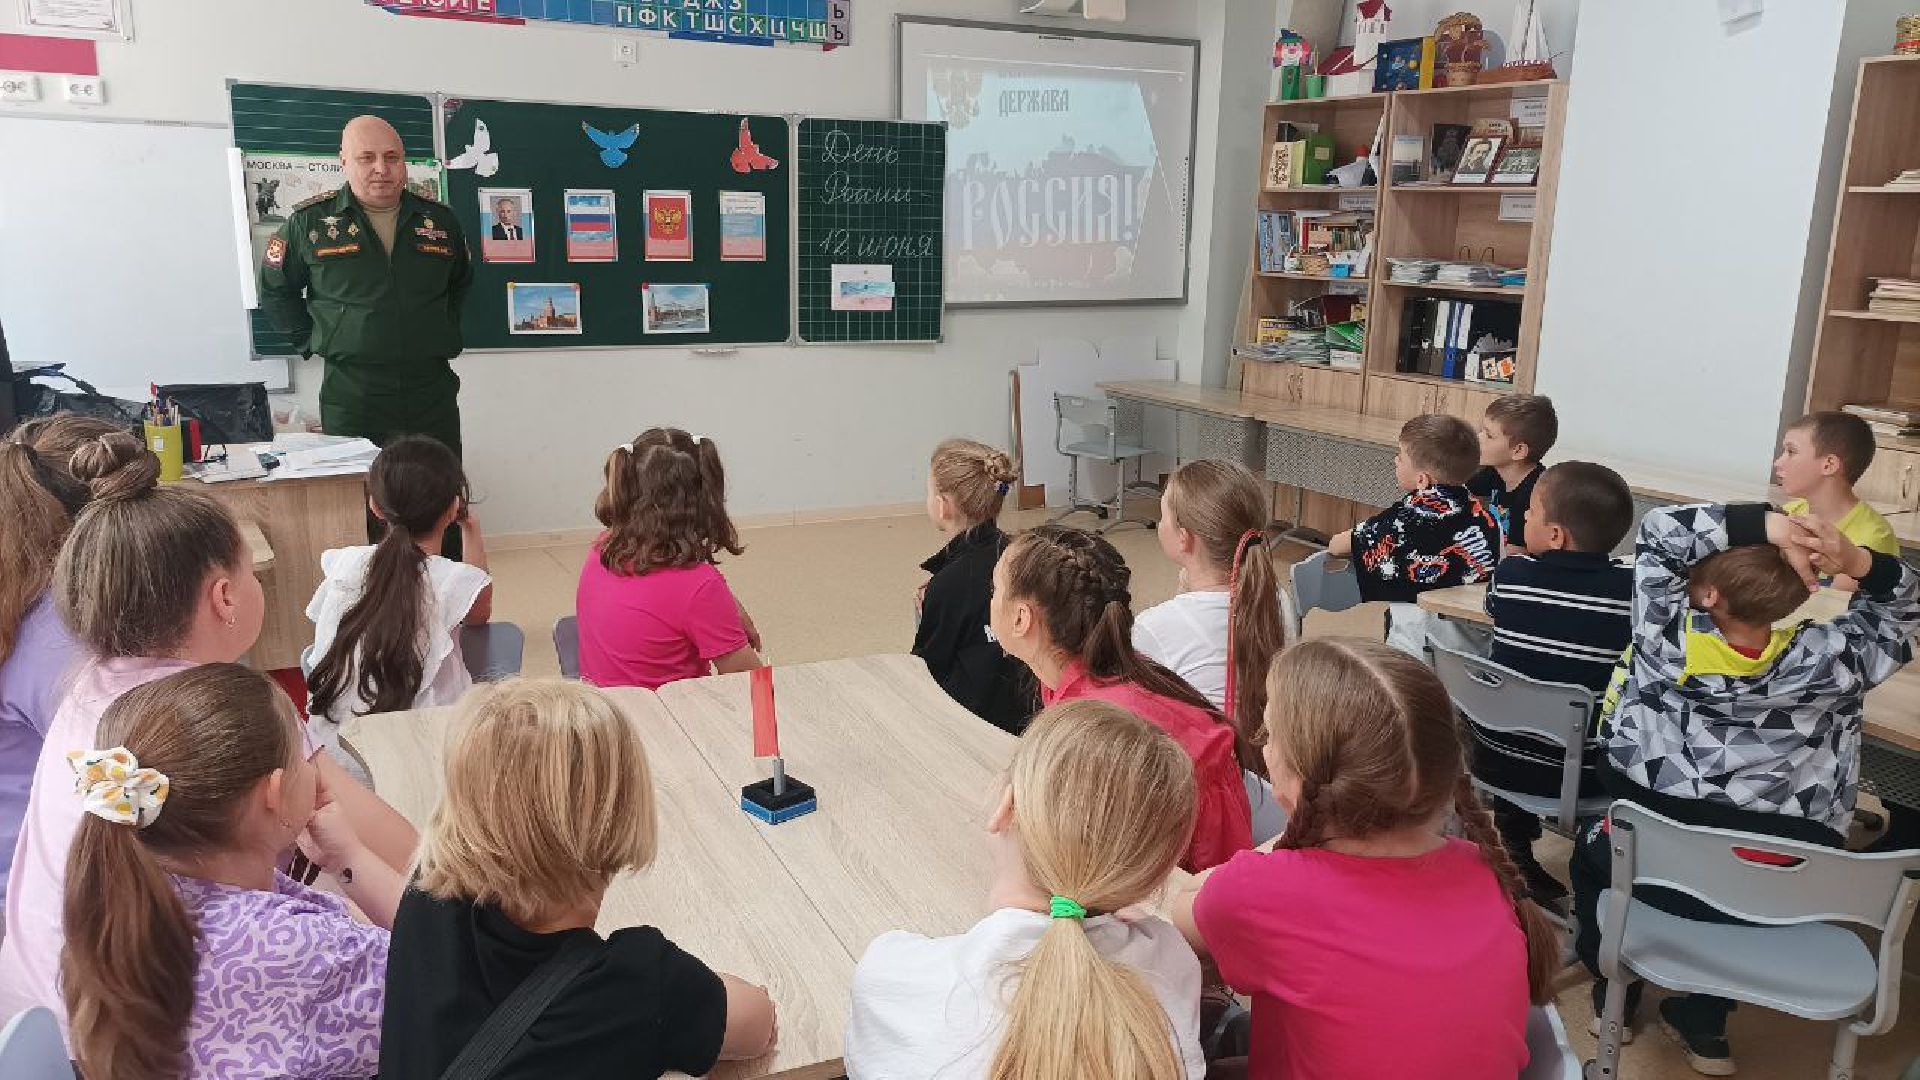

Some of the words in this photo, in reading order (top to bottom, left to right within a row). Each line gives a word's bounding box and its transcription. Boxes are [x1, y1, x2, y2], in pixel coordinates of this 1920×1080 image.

[617, 6, 632, 23] П
[638, 8, 658, 25] Ф
[663, 9, 677, 28] К
[684, 12, 701, 29] Т
[704, 13, 724, 32] Ш
[729, 15, 742, 34] С
[750, 17, 764, 35] Х
[771, 19, 786, 38] Ц
[791, 21, 805, 38] Ч
[999, 87, 1070, 117] ДЕРЖАВА
[821, 129, 899, 164] День
[246, 161, 293, 171] МОСКВА
[820, 170, 911, 205] России
[962, 174, 1135, 251] РОССИЯ!
[820, 229, 849, 256] 12
[858, 234, 935, 259] июня
